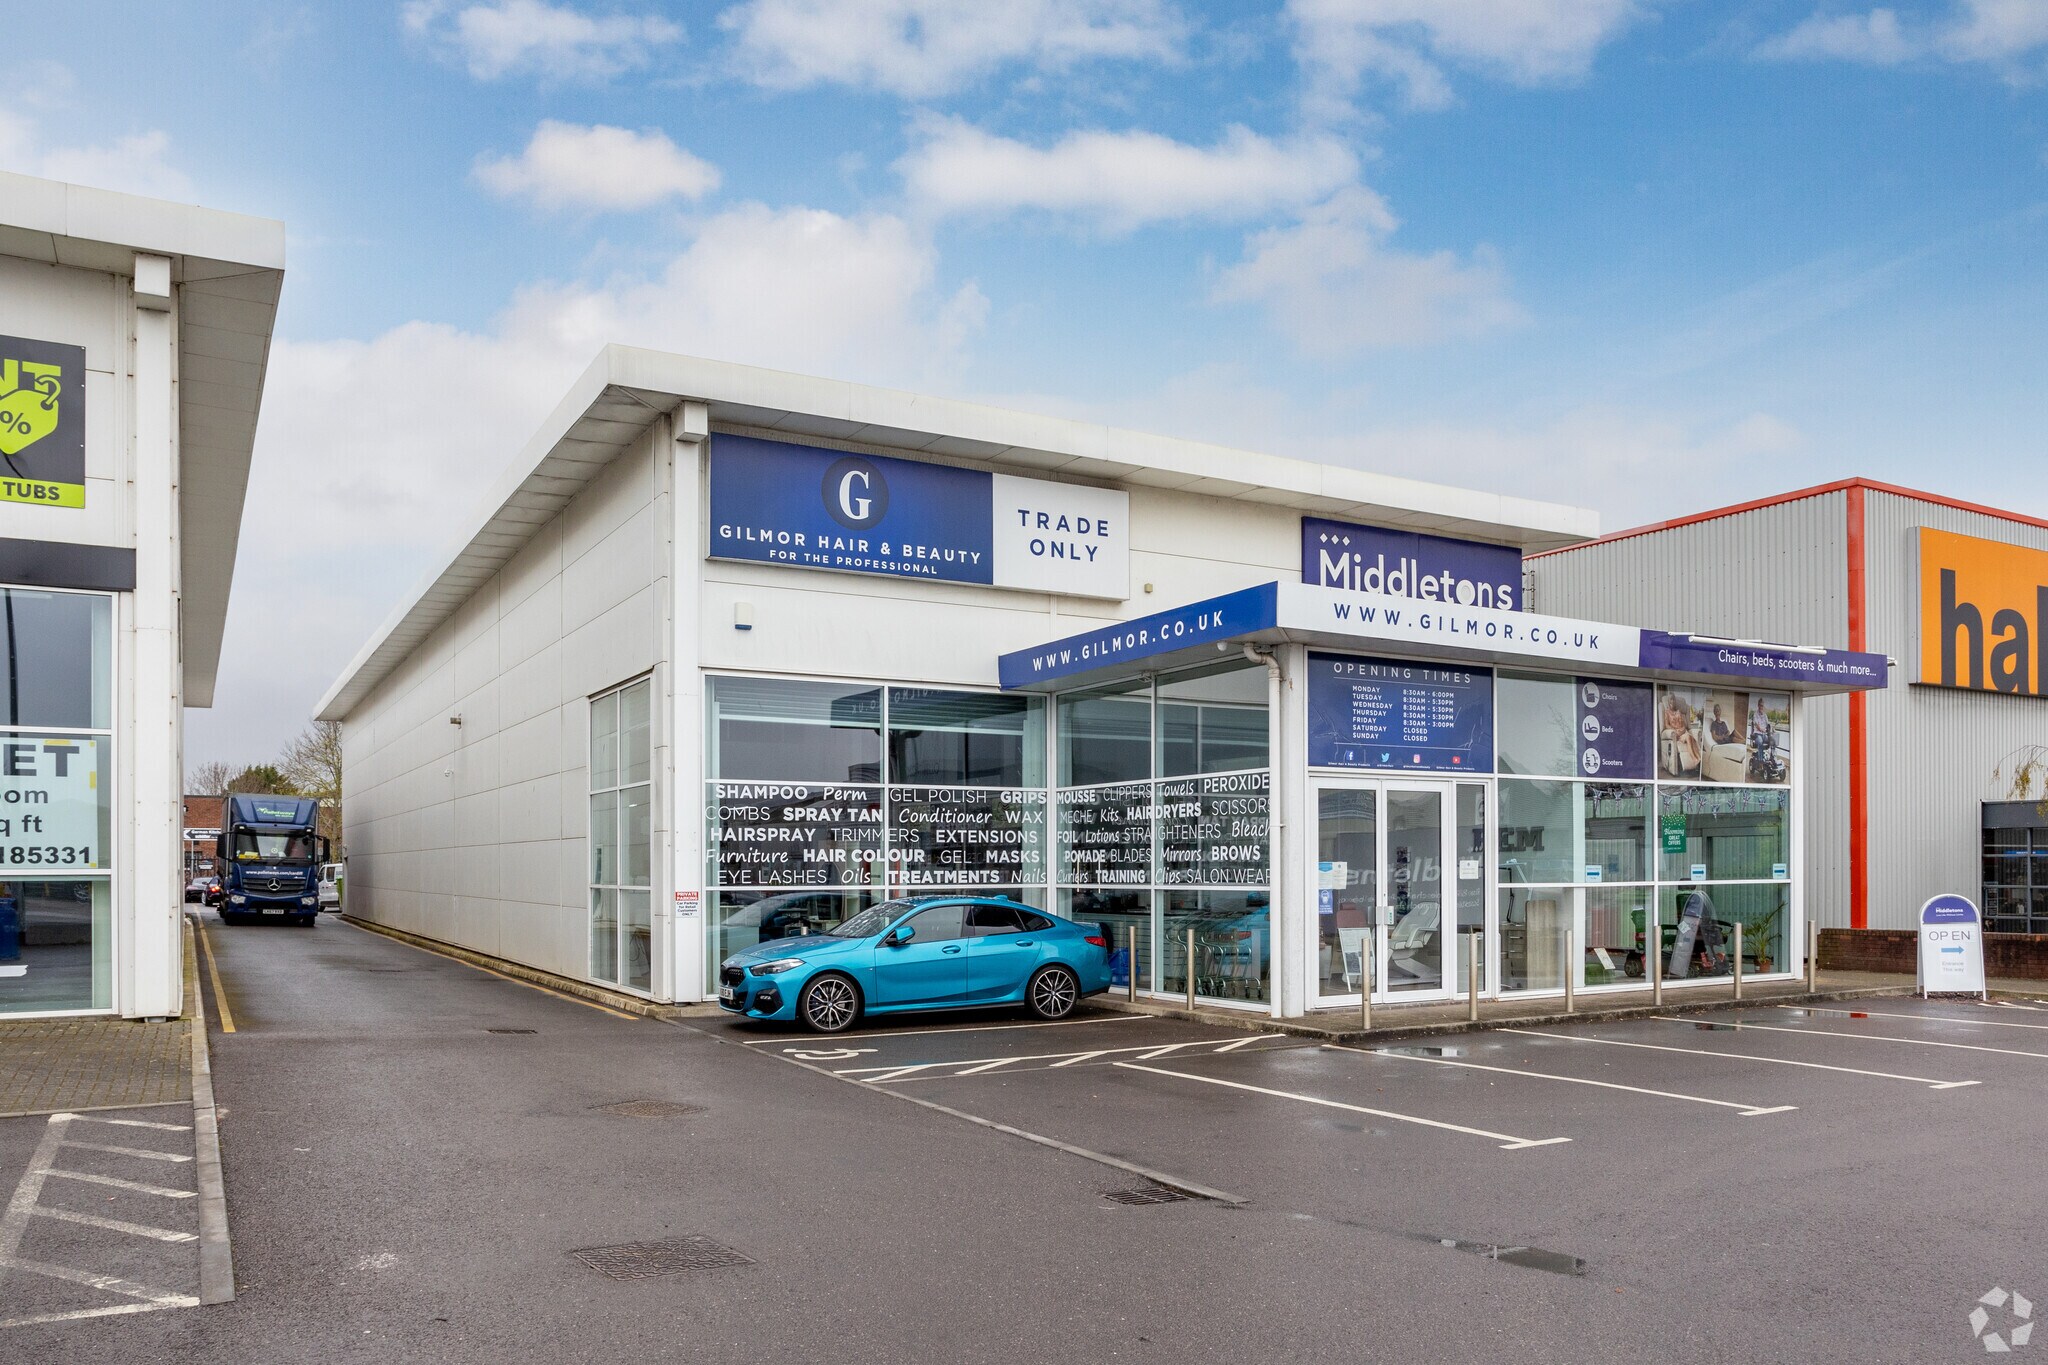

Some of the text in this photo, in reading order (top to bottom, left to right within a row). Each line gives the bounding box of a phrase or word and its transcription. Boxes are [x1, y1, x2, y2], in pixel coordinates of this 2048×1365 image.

[3, 481, 60, 501] TUBS
[838, 470, 872, 520] G
[1017, 509, 1110, 538] TRADE
[719, 524, 981, 565] GILMOR HAIR & BEAUTY
[1029, 539, 1099, 563] ONLY
[769, 549, 938, 575] FOR THE PROFESSIONAL
[1319, 548, 1513, 611] Middletons
[1333, 602, 1599, 650] WWW.GILMOR.CO.UK
[1032, 610, 1223, 672] WWW.GILMOR.CO.UK
[1718, 649, 1877, 676] Chairs, beds, scooters & much more...
[1333, 662, 1471, 684] OPENING TIMES
[1352, 685, 1381, 693] MONDAY
[1403, 689, 1426, 697] 8:30AM
[1352, 693, 1382, 701] TUESDAY
[1602, 692, 1618, 700] Chairs
[1352, 701, 1393, 710] WEDNESDAY
[1403, 704, 1426, 712] 8:30AM
[1352, 709, 1387, 717] THURSDAY
[1352, 716, 1376, 724] FRIDAY
[1352, 724, 1387, 732] SATURDAY
[1352, 732, 1379, 740] SUNDAY
[3, 744, 80, 777] ET
[0, 790, 49, 803] om
[715, 784, 1046, 804] SHAMPOO Perm GEL POLISH GRIPS
[1056, 774, 1270, 804] MOUSSE CLIPPERS Towels PEROXIDE
[704, 806, 1044, 824] COMBS SPRAY TAN Conditioner WAX
[1060, 810, 1093, 824] MECHE
[1100, 806, 1119, 822] Kits
[1126, 802, 1202, 820] HAIRDRYERS
[22, 814, 42, 833] ft
[710, 828, 1038, 844] HAIRSPRAY TRIMMERS EXTENSIONS
[1057, 830, 1078, 844] FOIL
[1085, 828, 1120, 843] Lotions
[1124, 824, 1221, 841] STRAIGHTENERS
[706, 848, 1040, 864] Furniture HAIR COLOUR GEL MASKS
[1064, 845, 1260, 862] POMADE BLADES Mirrors BROWS
[717, 869, 1046, 884] EYE LASHES Oils TREATMENTS Nails
[1057, 869, 1088, 884] Curlers
[1096, 870, 1146, 883] TRAINING
[1156, 866, 1180, 884] Clips
[1186, 868, 1229, 884] SALON
[1929, 931, 1971, 941] OPEN
